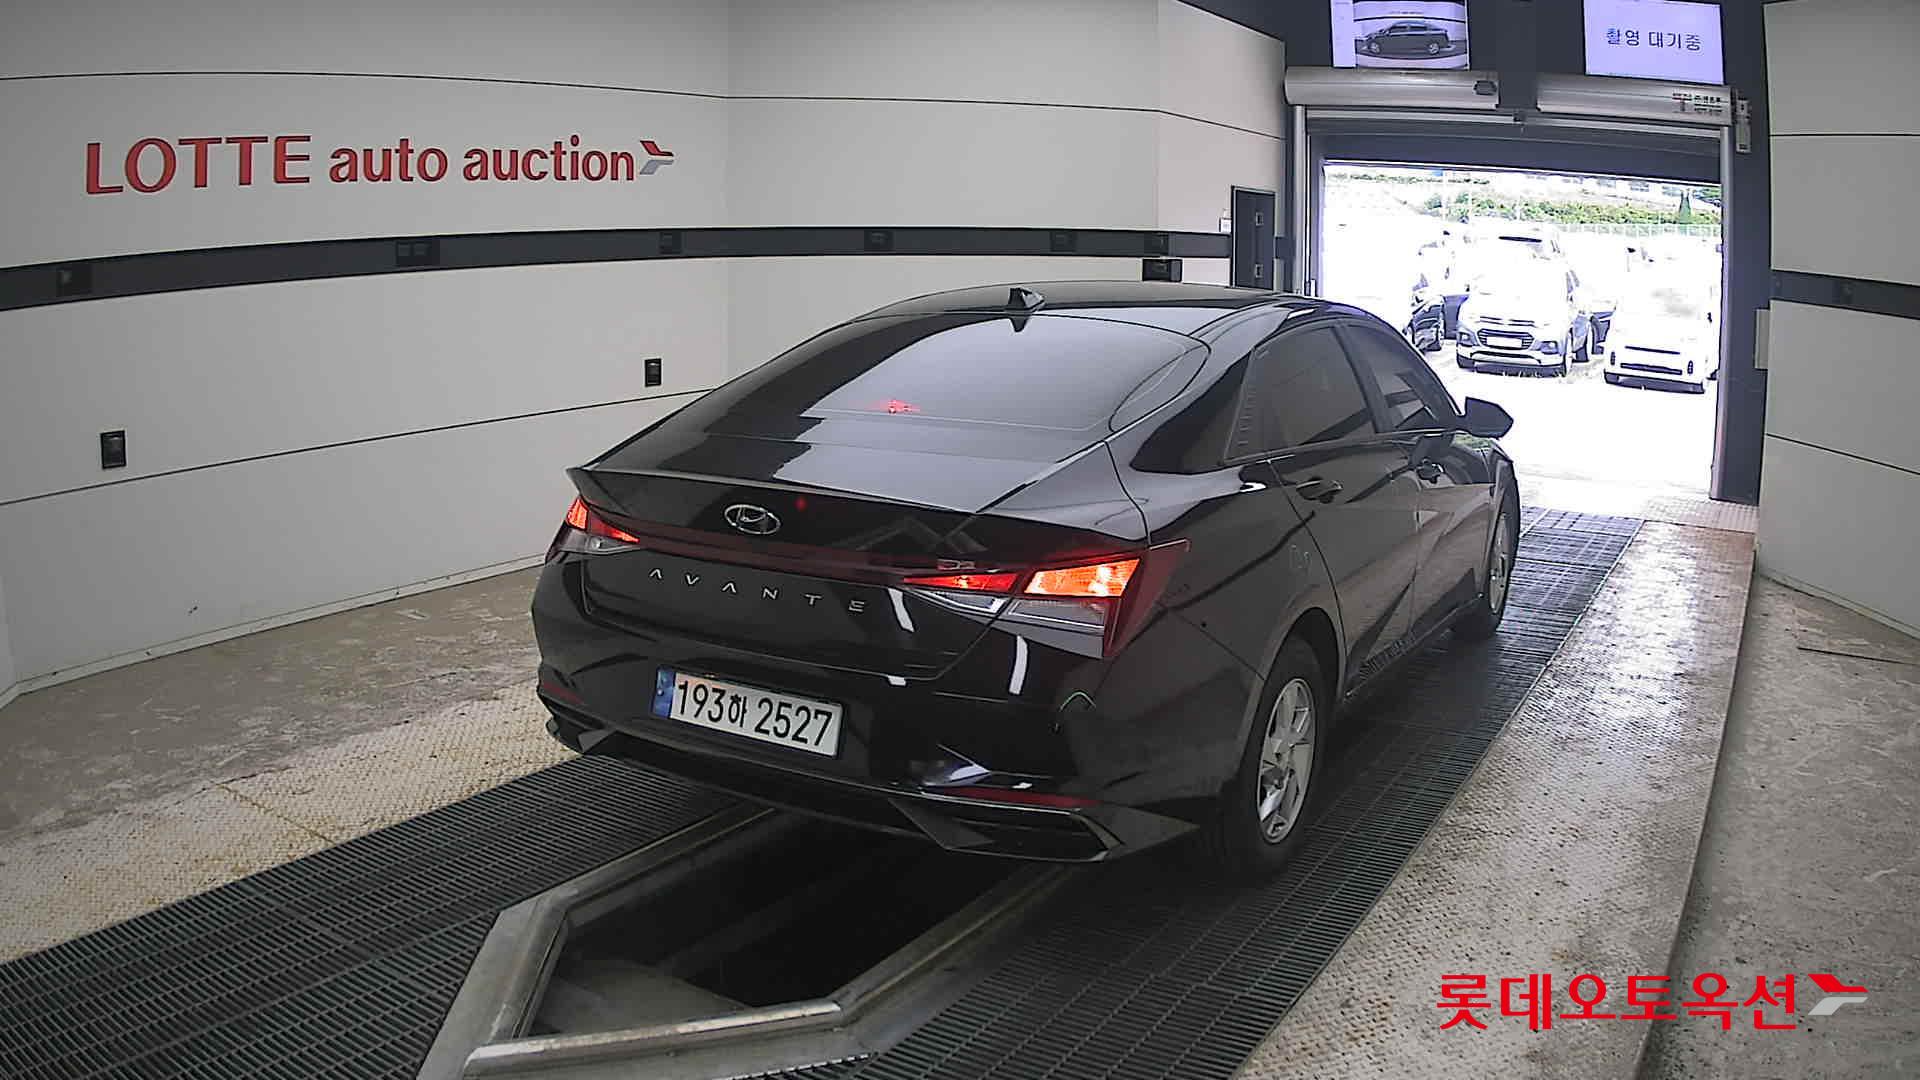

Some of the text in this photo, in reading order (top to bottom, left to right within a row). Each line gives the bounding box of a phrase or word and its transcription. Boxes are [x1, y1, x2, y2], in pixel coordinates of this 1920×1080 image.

[1606, 28, 1701, 51] 촬영 대기중
[86, 134, 635, 194] LOTTE auto auction
[649, 568, 866, 612] AVANTE
[678, 680, 834, 747] 193하 2527
